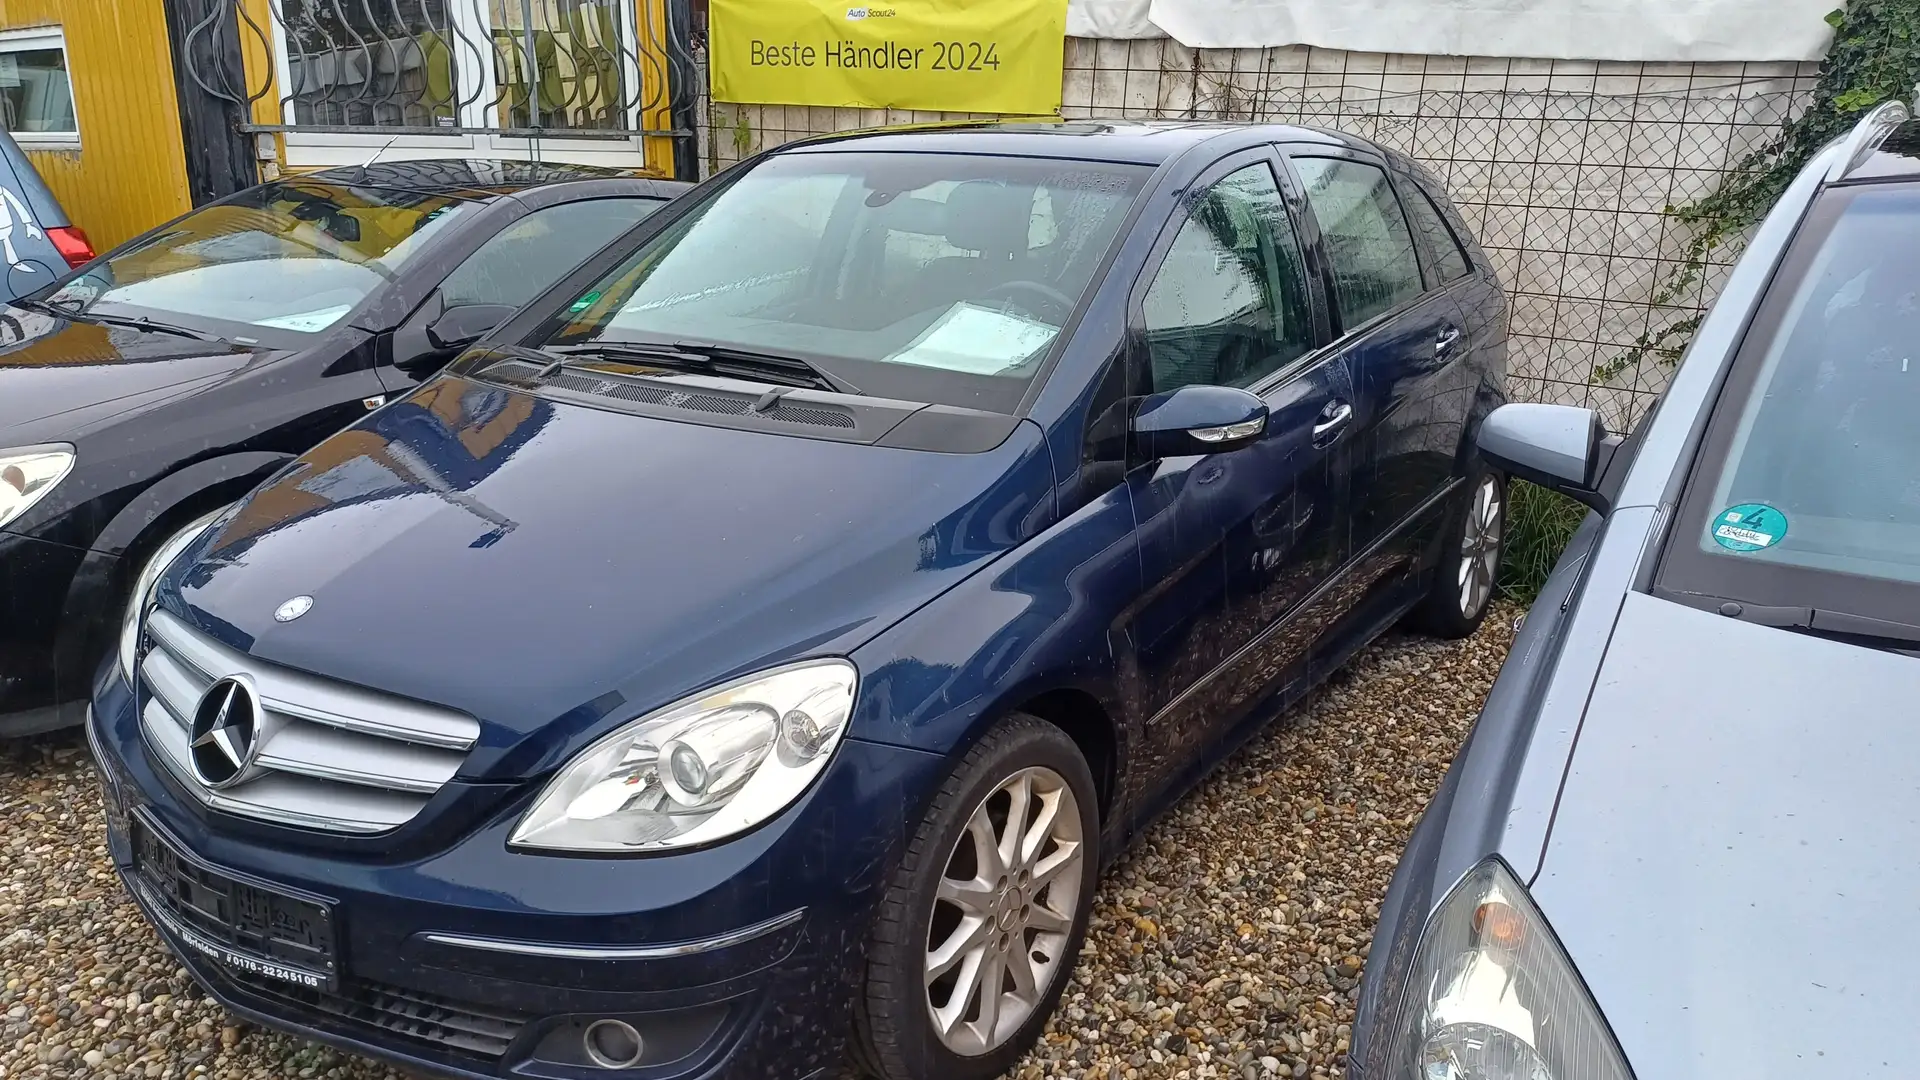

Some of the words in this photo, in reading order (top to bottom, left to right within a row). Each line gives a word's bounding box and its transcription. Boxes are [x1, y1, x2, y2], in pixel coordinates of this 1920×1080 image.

[847, 8, 866, 18] Auto
[867, 8, 896, 18] Scout24
[750, 39, 816, 67] Beste
[825, 40, 924, 70] Händler
[931, 41, 1001, 71] 2024
[1741, 507, 1767, 529] 4
